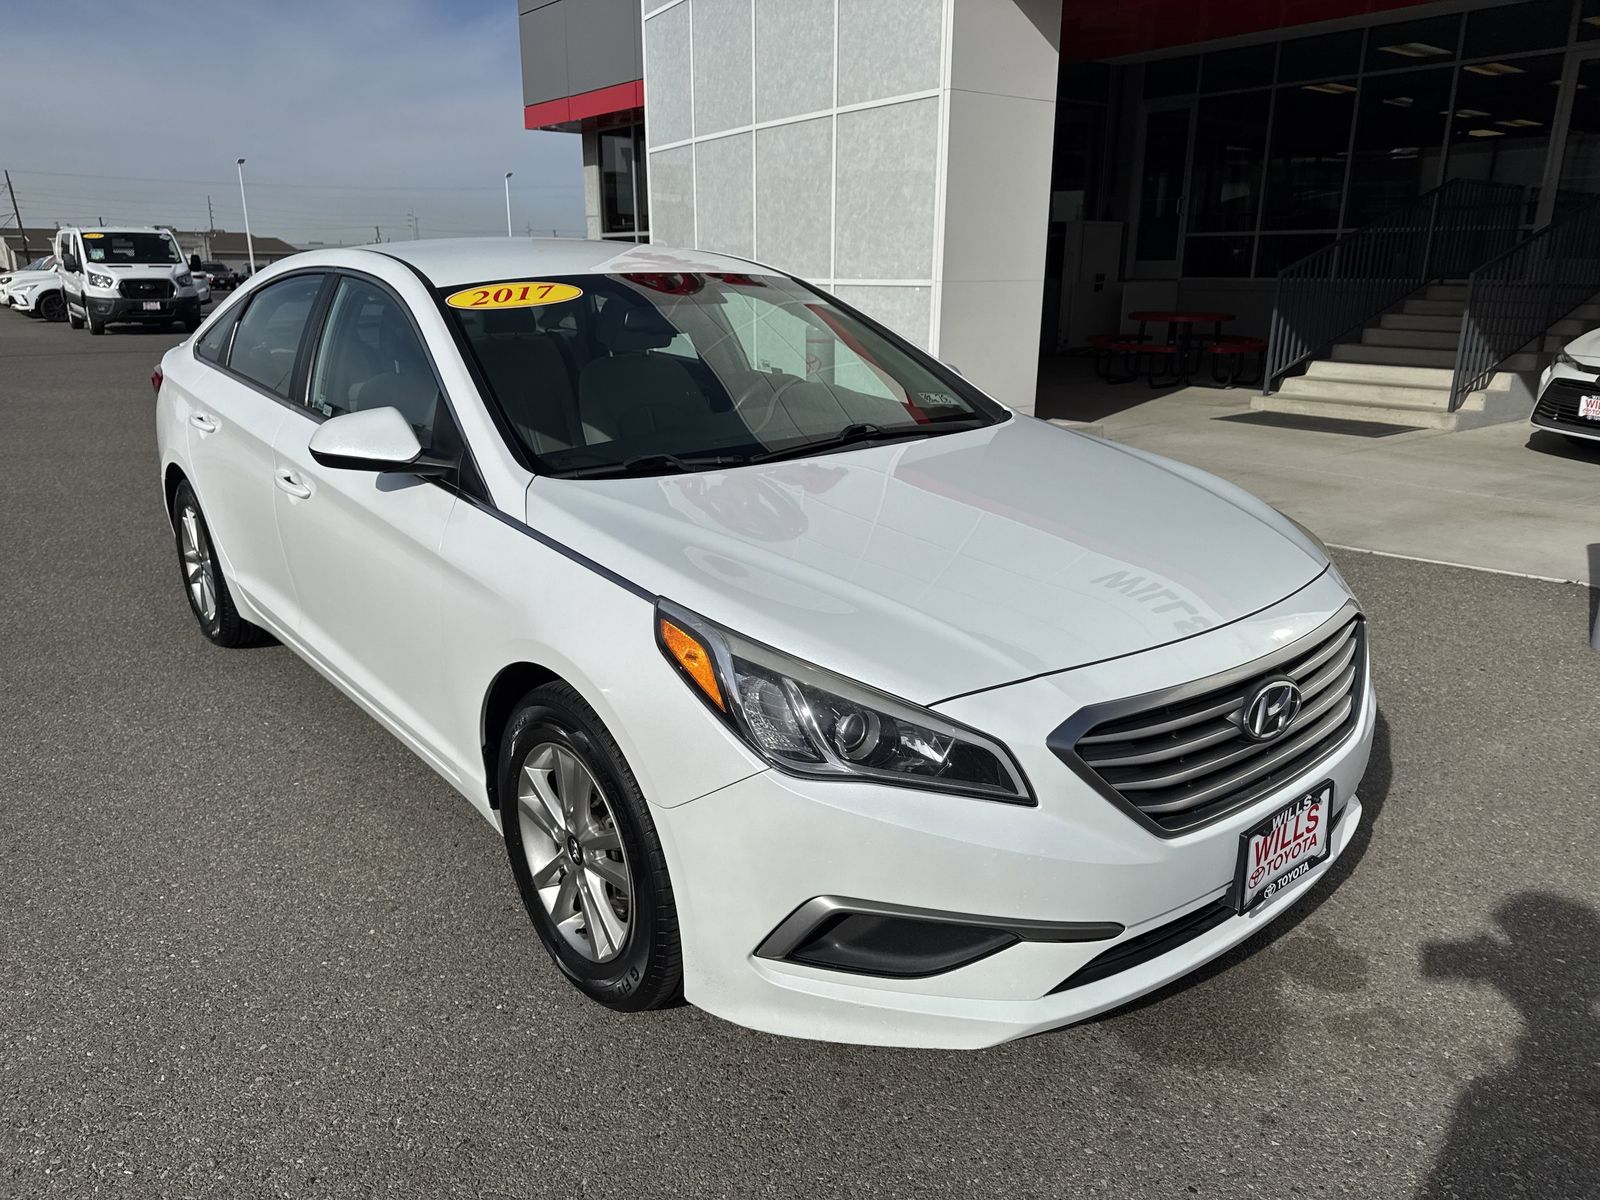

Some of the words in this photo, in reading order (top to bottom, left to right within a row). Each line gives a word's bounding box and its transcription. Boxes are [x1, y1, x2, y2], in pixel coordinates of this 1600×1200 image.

[470, 285, 555, 307] 2017
[1272, 794, 1312, 832] WILLS
[1255, 804, 1320, 867] WILLS
[1266, 833, 1318, 876] TOYOTA
[1277, 861, 1310, 889] TOYOTA
